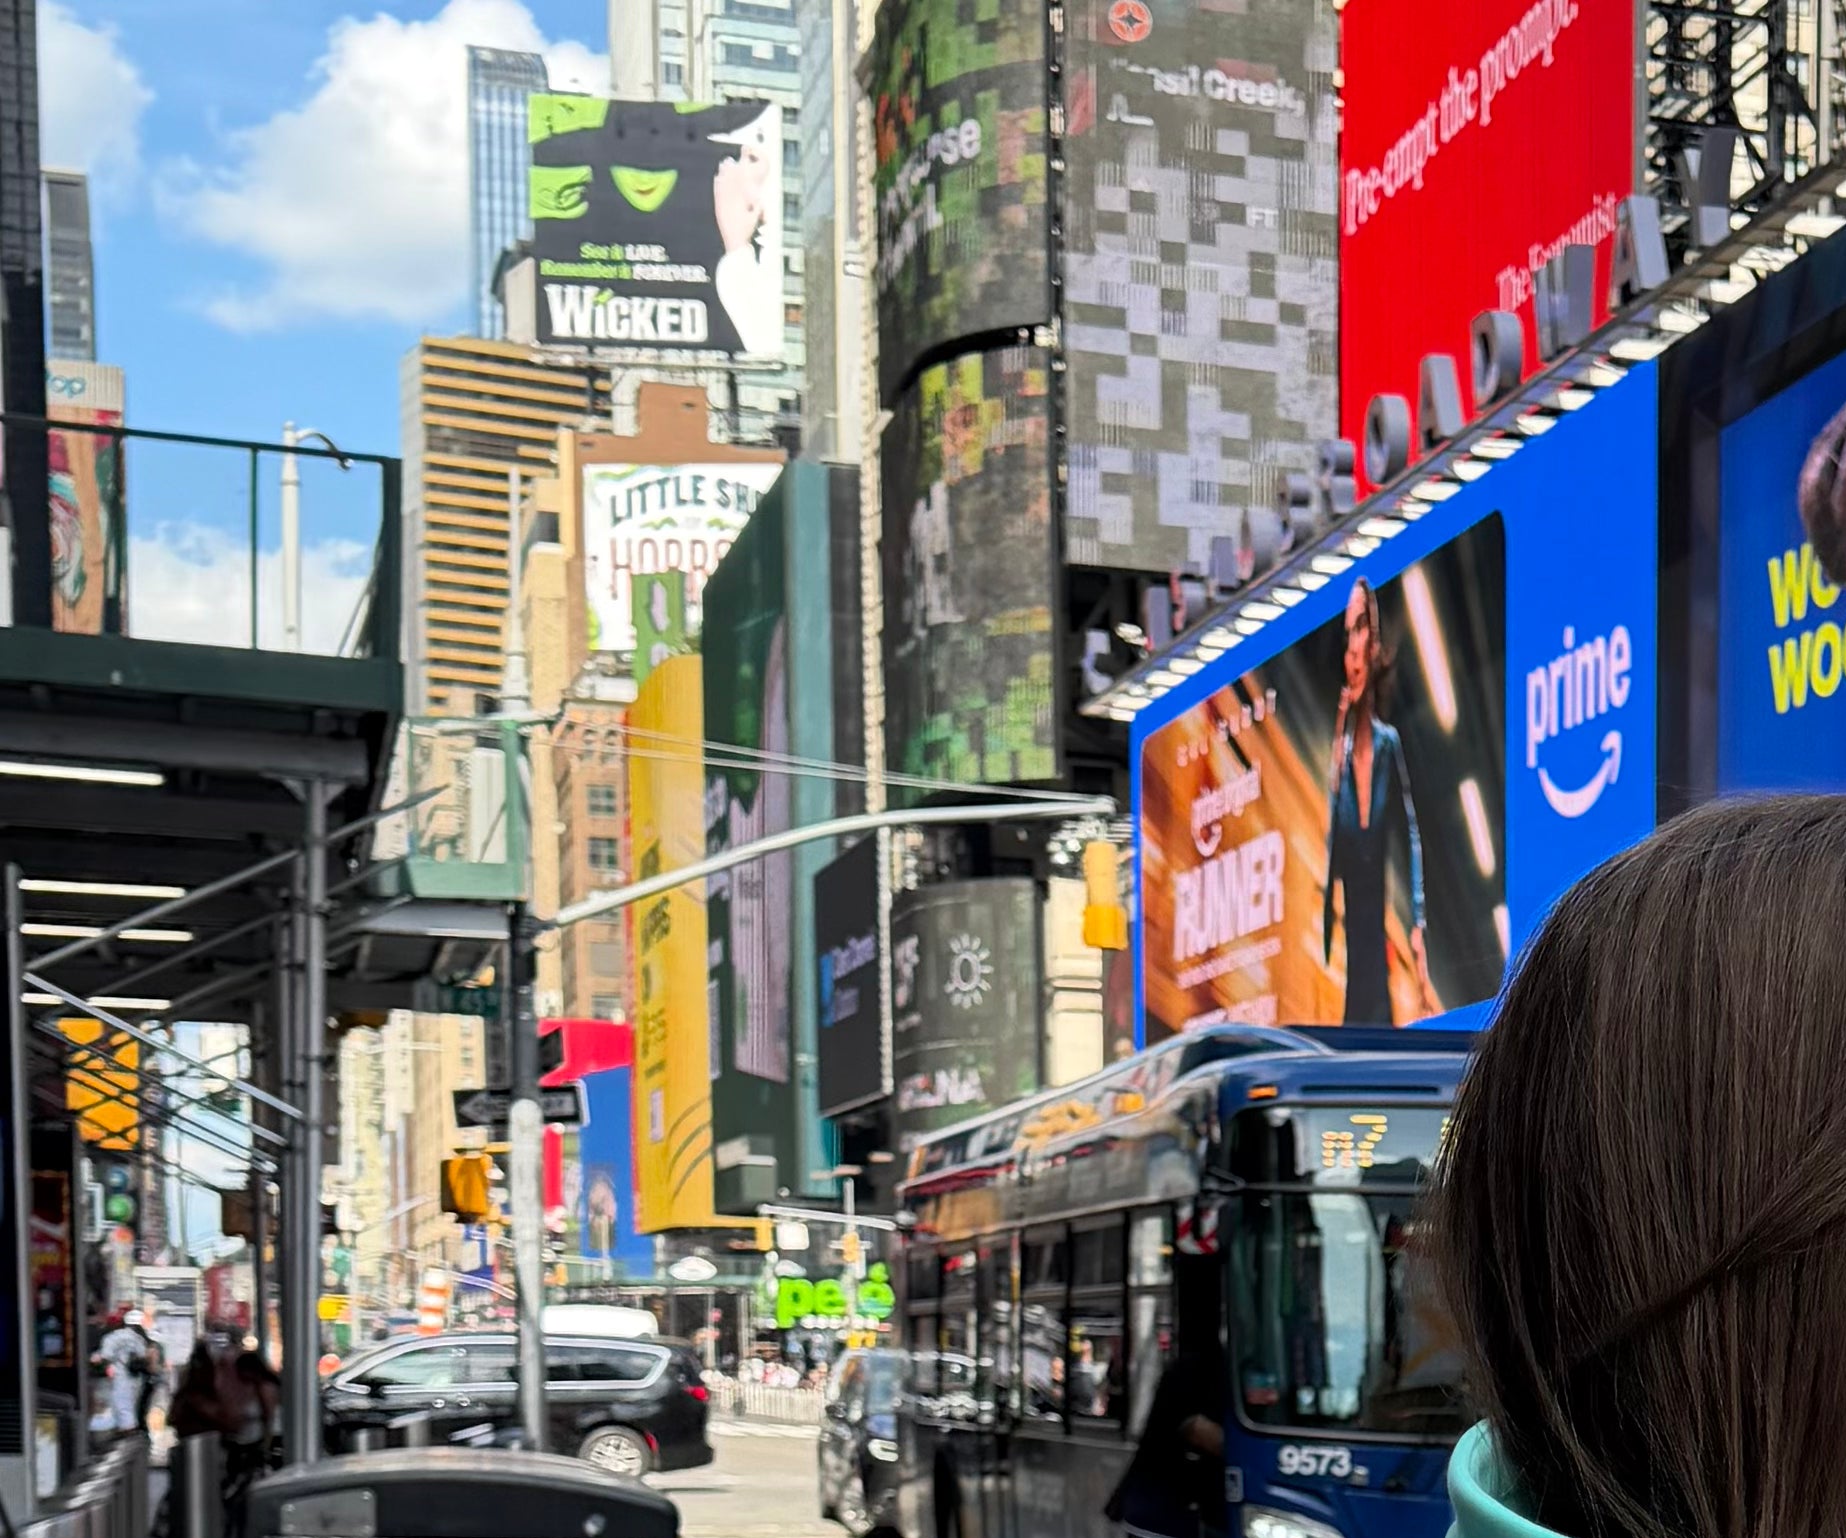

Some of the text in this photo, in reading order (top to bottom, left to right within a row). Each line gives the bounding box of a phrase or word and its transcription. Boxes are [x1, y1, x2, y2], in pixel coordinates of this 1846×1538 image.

[1440, 65, 1479, 143] the
[610, 474, 706, 527] LITTLE
[1525, 624, 1632, 769] prime
[1278, 1445, 1352, 1477] 9573
